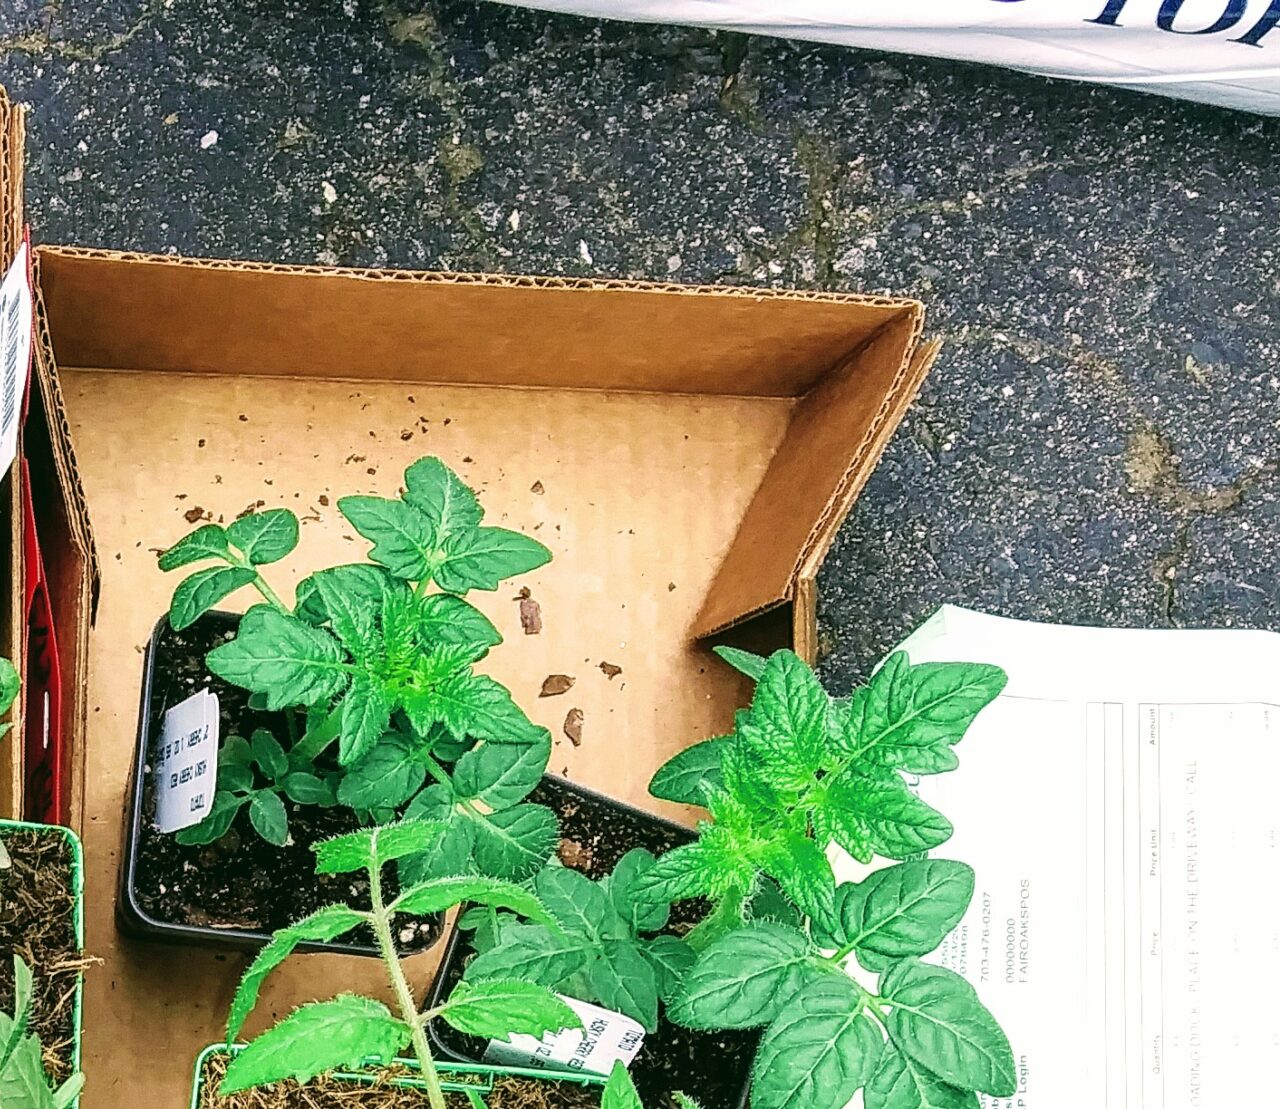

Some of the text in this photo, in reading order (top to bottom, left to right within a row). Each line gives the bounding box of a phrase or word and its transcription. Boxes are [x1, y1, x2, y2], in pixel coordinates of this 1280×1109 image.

[1148, 708, 1156, 746] Amount
[1149, 852, 1158, 876] Price
[981, 891, 991, 982] 703-476-0207
[1018, 878, 1030, 983] FAIROAKSPOS
[1018, 1055, 1029, 1094] Login
[1151, 1034, 1162, 1075] Quantity
